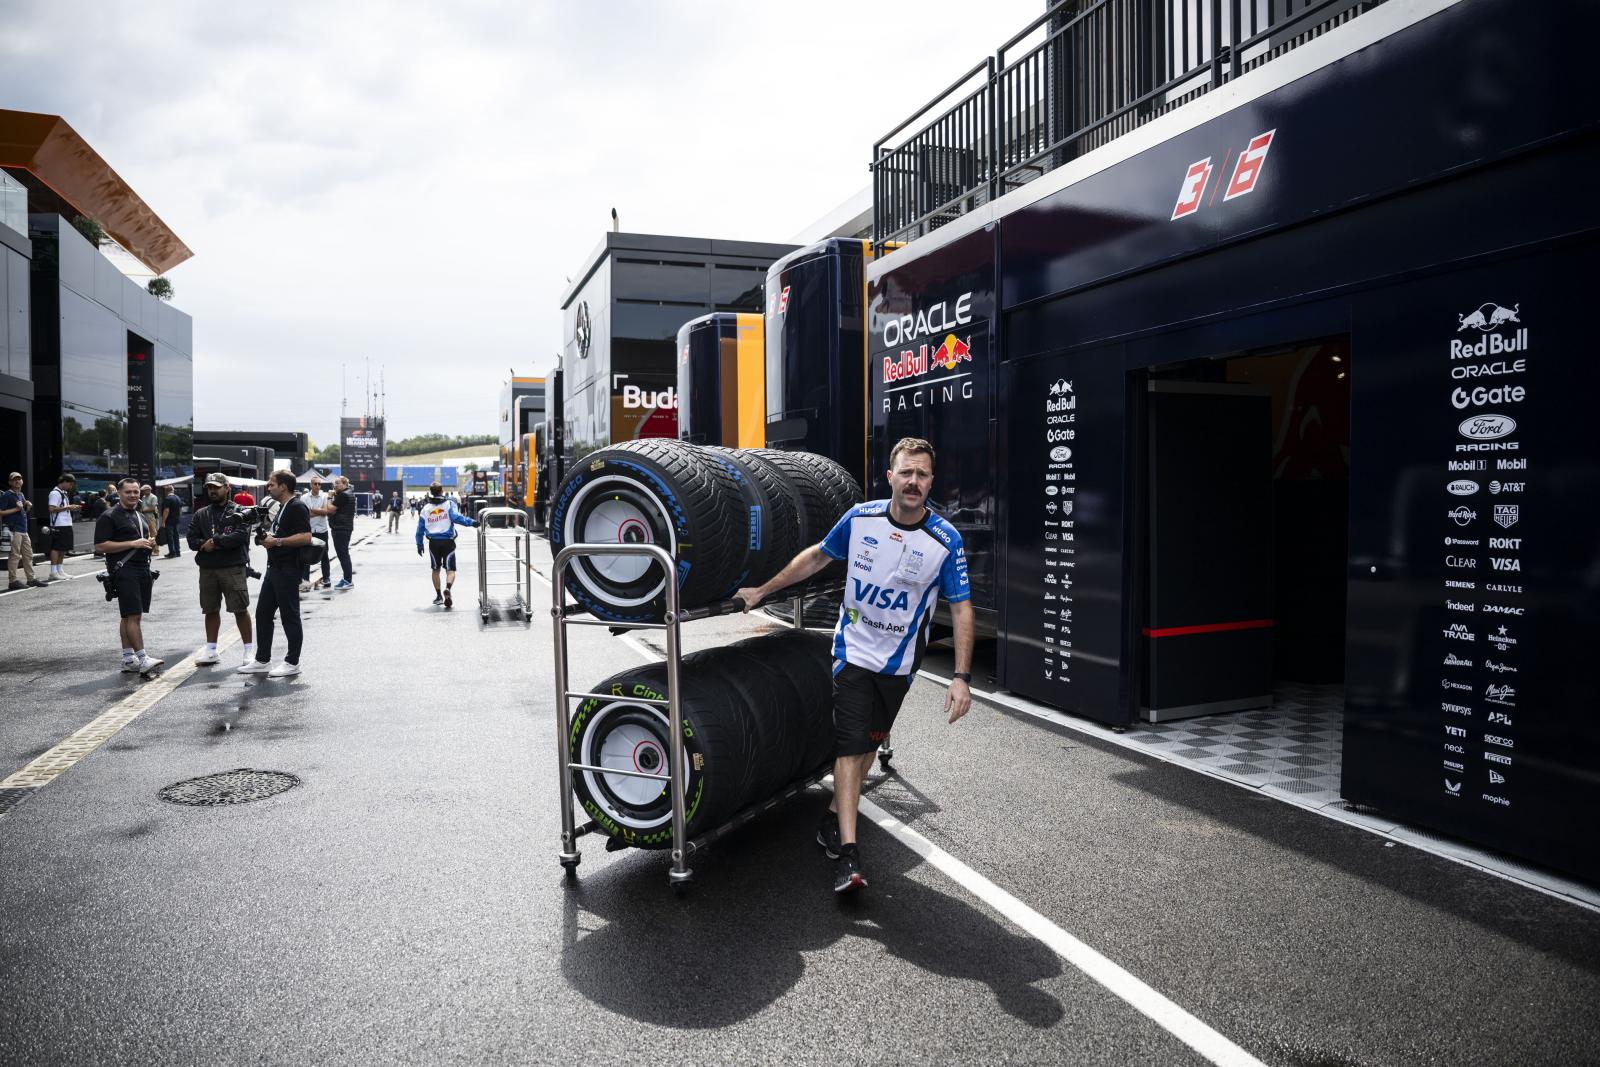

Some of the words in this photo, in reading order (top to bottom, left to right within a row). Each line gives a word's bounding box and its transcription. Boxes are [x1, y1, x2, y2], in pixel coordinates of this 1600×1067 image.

[883, 292, 972, 347] ORACLE
[1450, 334, 1487, 360] Red
[1489, 328, 1528, 354] Bull
[883, 351, 906, 383] Red
[906, 344, 928, 377] Bull
[1451, 359, 1526, 379] ORACLE
[883, 381, 973, 413] RACING
[1471, 385, 1526, 406] Gate
[1046, 398, 1061, 412] Red
[1061, 395, 1076, 410] Bull
[1047, 414, 1075, 425] ORACLE
[1470, 420, 1503, 435] Ford
[1054, 429, 1076, 441] Gate
[1456, 442, 1519, 452] RACING
[1448, 460, 1476, 471] Mobil
[1496, 458, 1527, 470] Mobil
[1502, 483, 1526, 492] AT&T
[552, 474, 583, 544] Cinturato
[1495, 515, 1517, 526] HEUER
[932, 525, 951, 543] HUGO
[1062, 533, 1074, 541] VISA
[1489, 538, 1522, 550] ROKT
[853, 561, 872, 572] Mobil
[1446, 556, 1477, 568] CLEAR
[1490, 558, 1521, 571] VISA
[1445, 581, 1476, 589] SIEMENS
[1486, 584, 1523, 593] CARLYLE
[851, 577, 909, 611] VISA
[1446, 600, 1475, 612] indeed
[1483, 605, 1525, 616] DAMAC
[861, 615, 885, 630] Cash
[886, 622, 905, 633] App
[1443, 630, 1475, 641] TRADE
[1488, 634, 1517, 644] Heineken
[1451, 682, 1473, 691] HEXAGON
[1442, 703, 1472, 716] SYNOPSYS
[1445, 725, 1466, 738] YETI
[1484, 734, 1514, 747] sparco
[1485, 752, 1512, 765] PIRELLI
[1482, 793, 1511, 806] mophie
